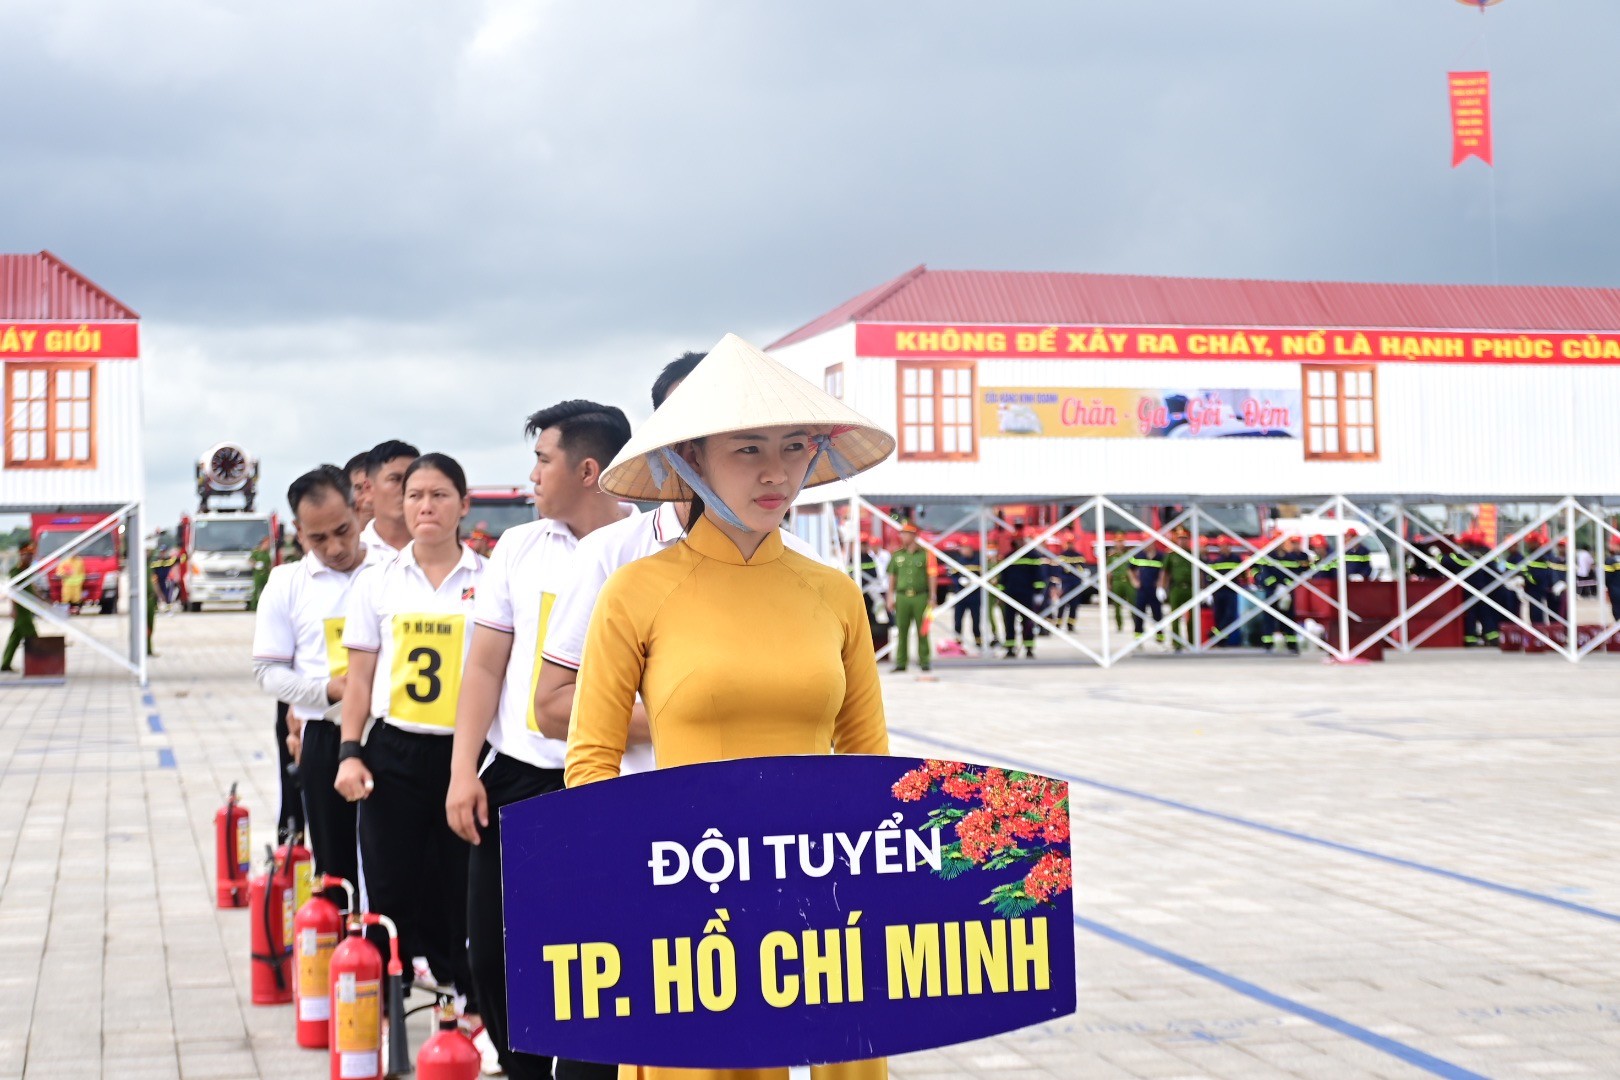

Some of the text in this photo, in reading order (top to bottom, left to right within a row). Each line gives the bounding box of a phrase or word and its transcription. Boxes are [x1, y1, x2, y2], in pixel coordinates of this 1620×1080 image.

[0, 324, 101, 352] ÁY GIỎI
[896, 326, 1620, 360] KHÔNG ĐỂ XẢY RA CHÁY, NỔ LÀ HẠNH PHÚC CỦA
[1061, 398, 1118, 427] Chăn
[1137, 397, 1170, 436] Ga
[1184, 392, 1224, 436] Gối
[1242, 397, 1292, 434] Đệm
[405, 646, 442, 704] 3
[648, 812, 942, 893] ĐỘI TUYỂN
[543, 908, 1051, 1021] TP. HỒ CHÍ MINH
